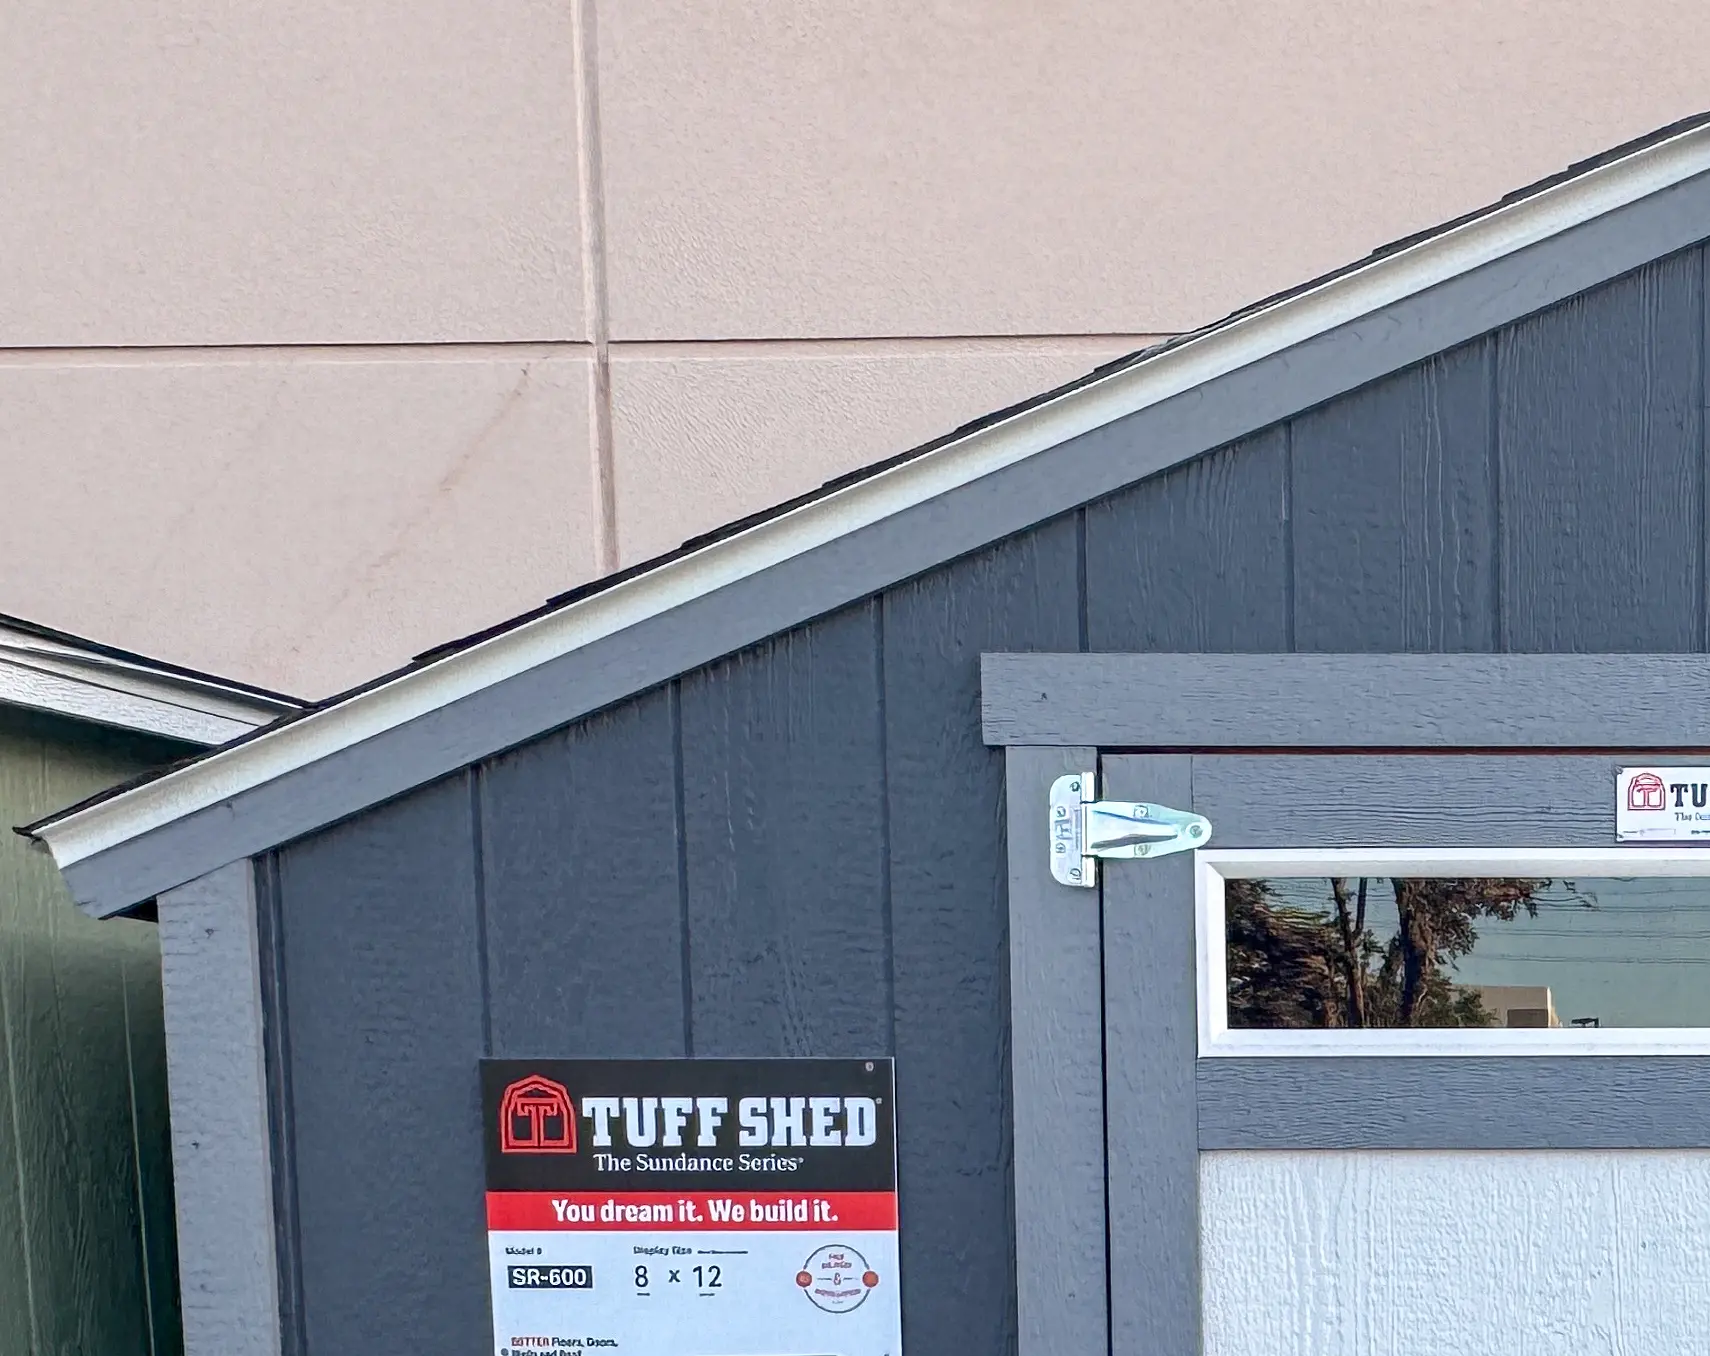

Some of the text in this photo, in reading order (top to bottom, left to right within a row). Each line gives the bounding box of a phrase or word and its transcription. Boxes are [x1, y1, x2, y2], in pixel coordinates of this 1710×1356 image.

[581, 1096, 878, 1148] TUFF SHED
[594, 1153, 632, 1173] The
[635, 1152, 733, 1173] Sundance
[551, 1199, 839, 1222] You dream it. We build it.
[511, 1264, 723, 1288] SR-600 8 x 12
